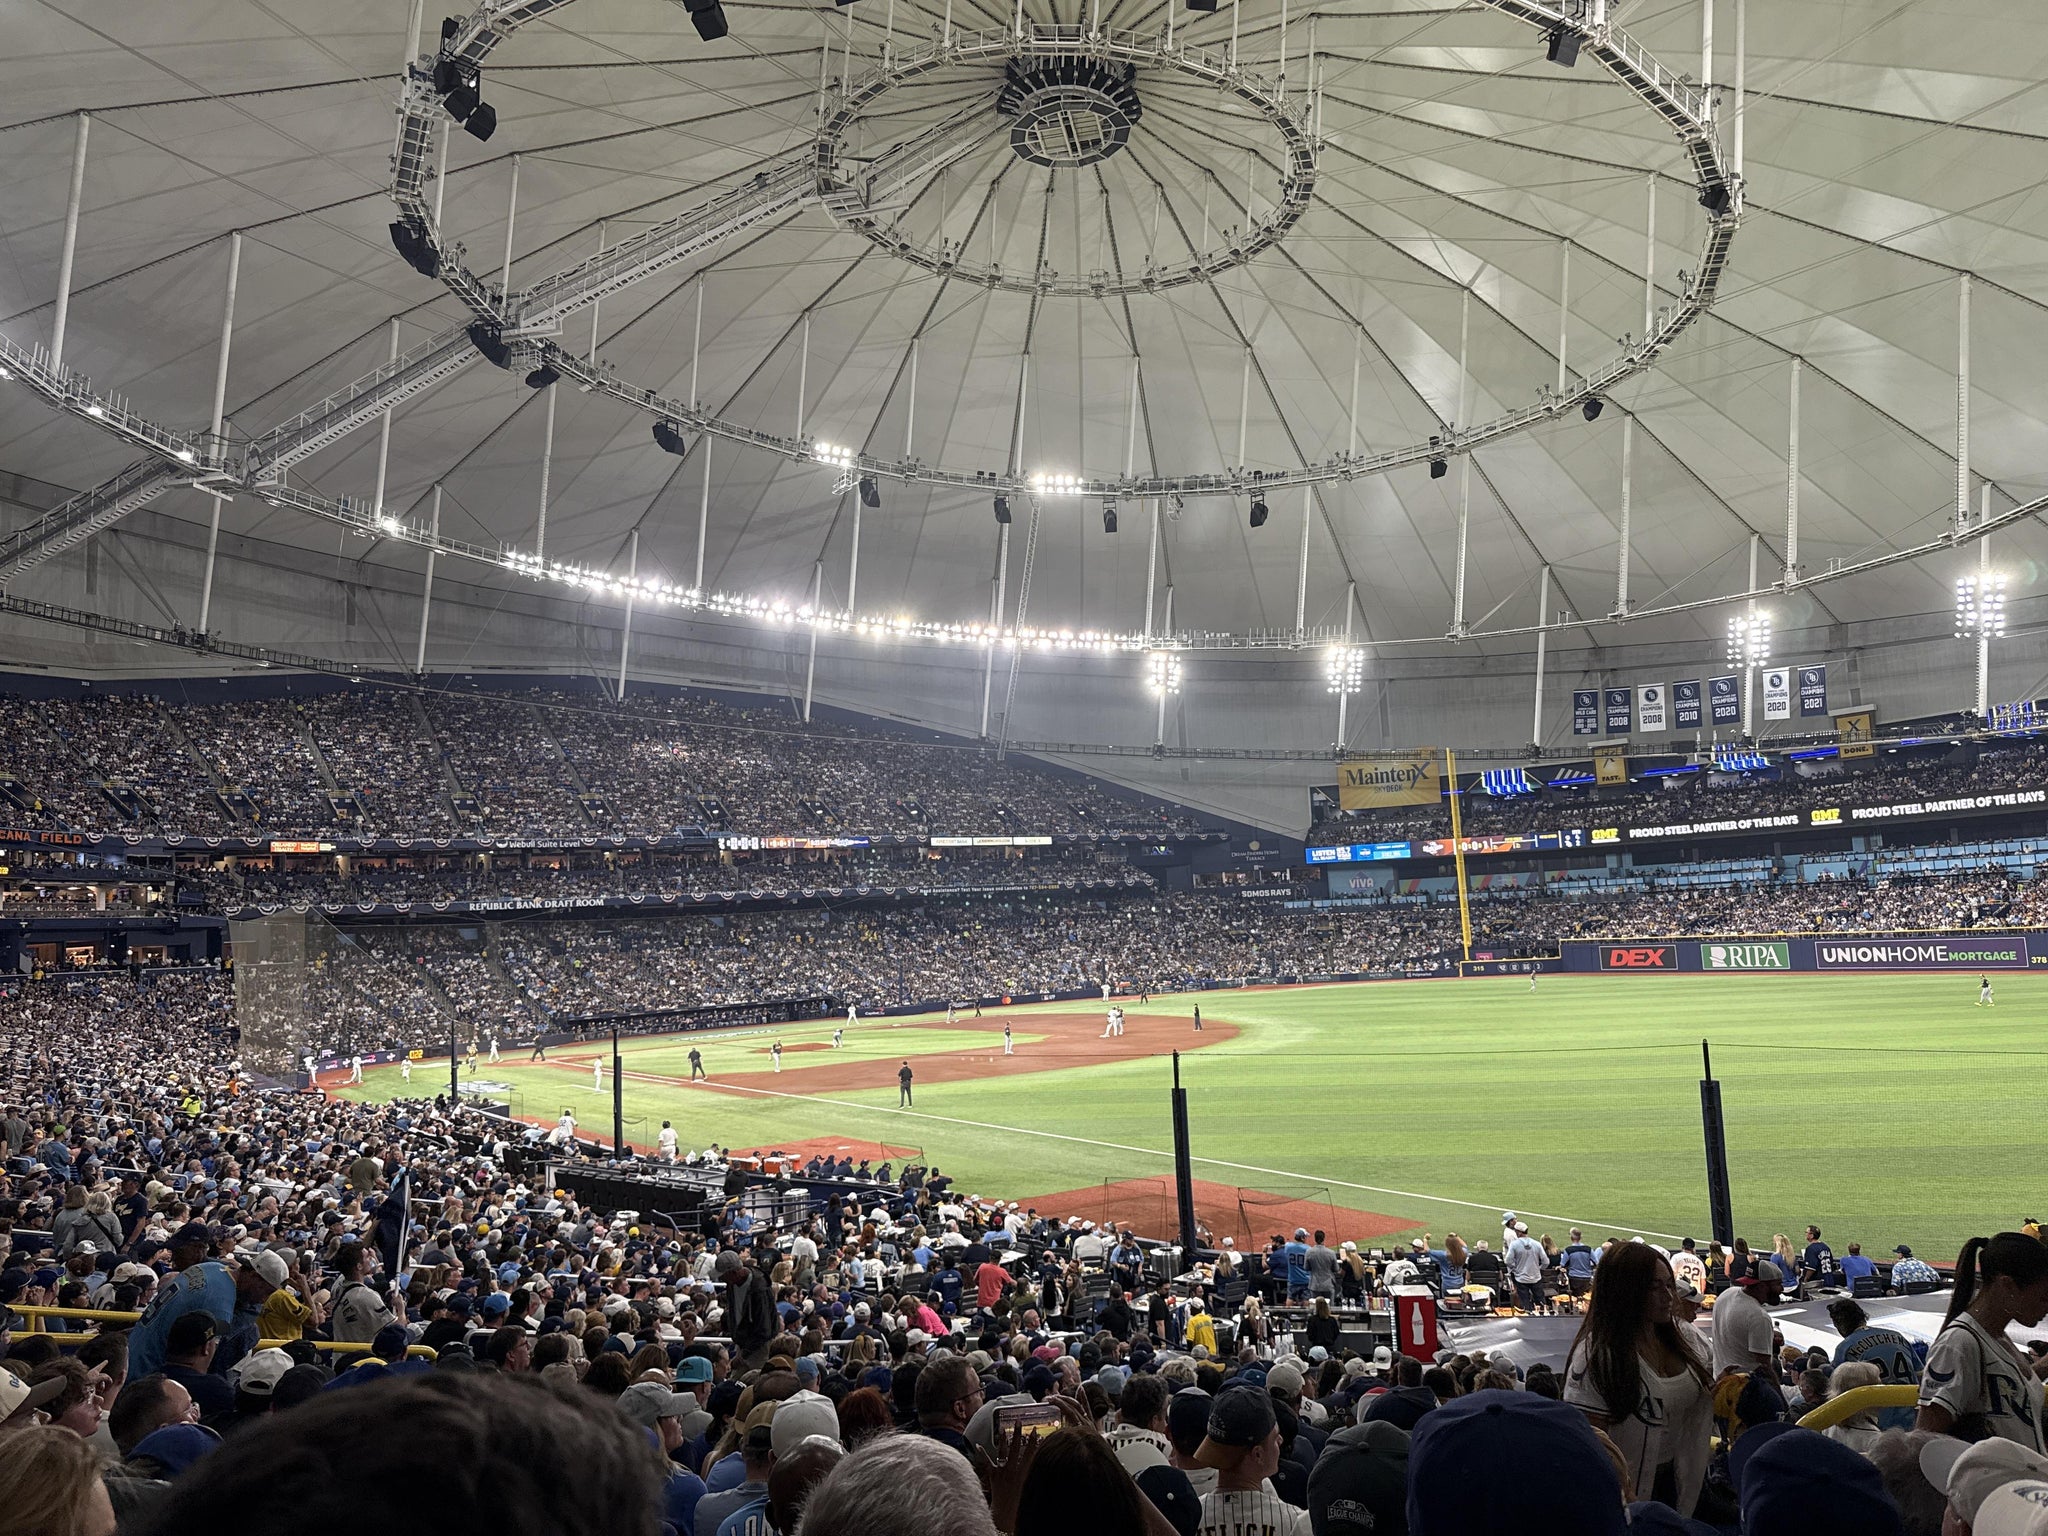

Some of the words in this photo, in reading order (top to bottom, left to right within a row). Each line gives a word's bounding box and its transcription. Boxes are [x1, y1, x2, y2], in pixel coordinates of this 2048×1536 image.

[1768, 702, 1786, 711] 2020
[1804, 698, 1822, 708] 2021
[1680, 711, 1698, 720] 2010
[1715, 706, 1736, 717] 2020
[1609, 716, 1628, 726] 2008
[1642, 714, 1662, 724] 2008
[1852, 807, 1890, 820] PROUD
[1891, 804, 1924, 816] STEEL
[1925, 800, 1976, 812] PARTNER
[1977, 796, 1992, 808] OF
[1993, 794, 2016, 806] THE
[2018, 791, 2046, 804] RAYS
[1630, 828, 1664, 838] PROUD
[1664, 825, 1694, 836] STEEL
[1694, 821, 1738, 833] PARTNER
[1738, 819, 1752, 829] OF
[1752, 816, 1774, 828] THE
[1774, 814, 1799, 826] RAYS
[41, 832, 82, 844] FIELD
[509, 840, 536, 848] Webull
[538, 840, 558, 848] Suite
[560, 840, 580, 848] Level
[469, 901, 515, 911] REPUBLIC
[516, 901, 542, 909] BANK
[544, 900, 575, 908] DRAFT
[1610, 948, 1666, 966] DEX
[1729, 945, 1782, 968] RIPA
[1949, 951, 2017, 961] MORTGAGE
[1289, 1254, 1304, 1265] 20
[1683, 1266, 1700, 1282] 22
